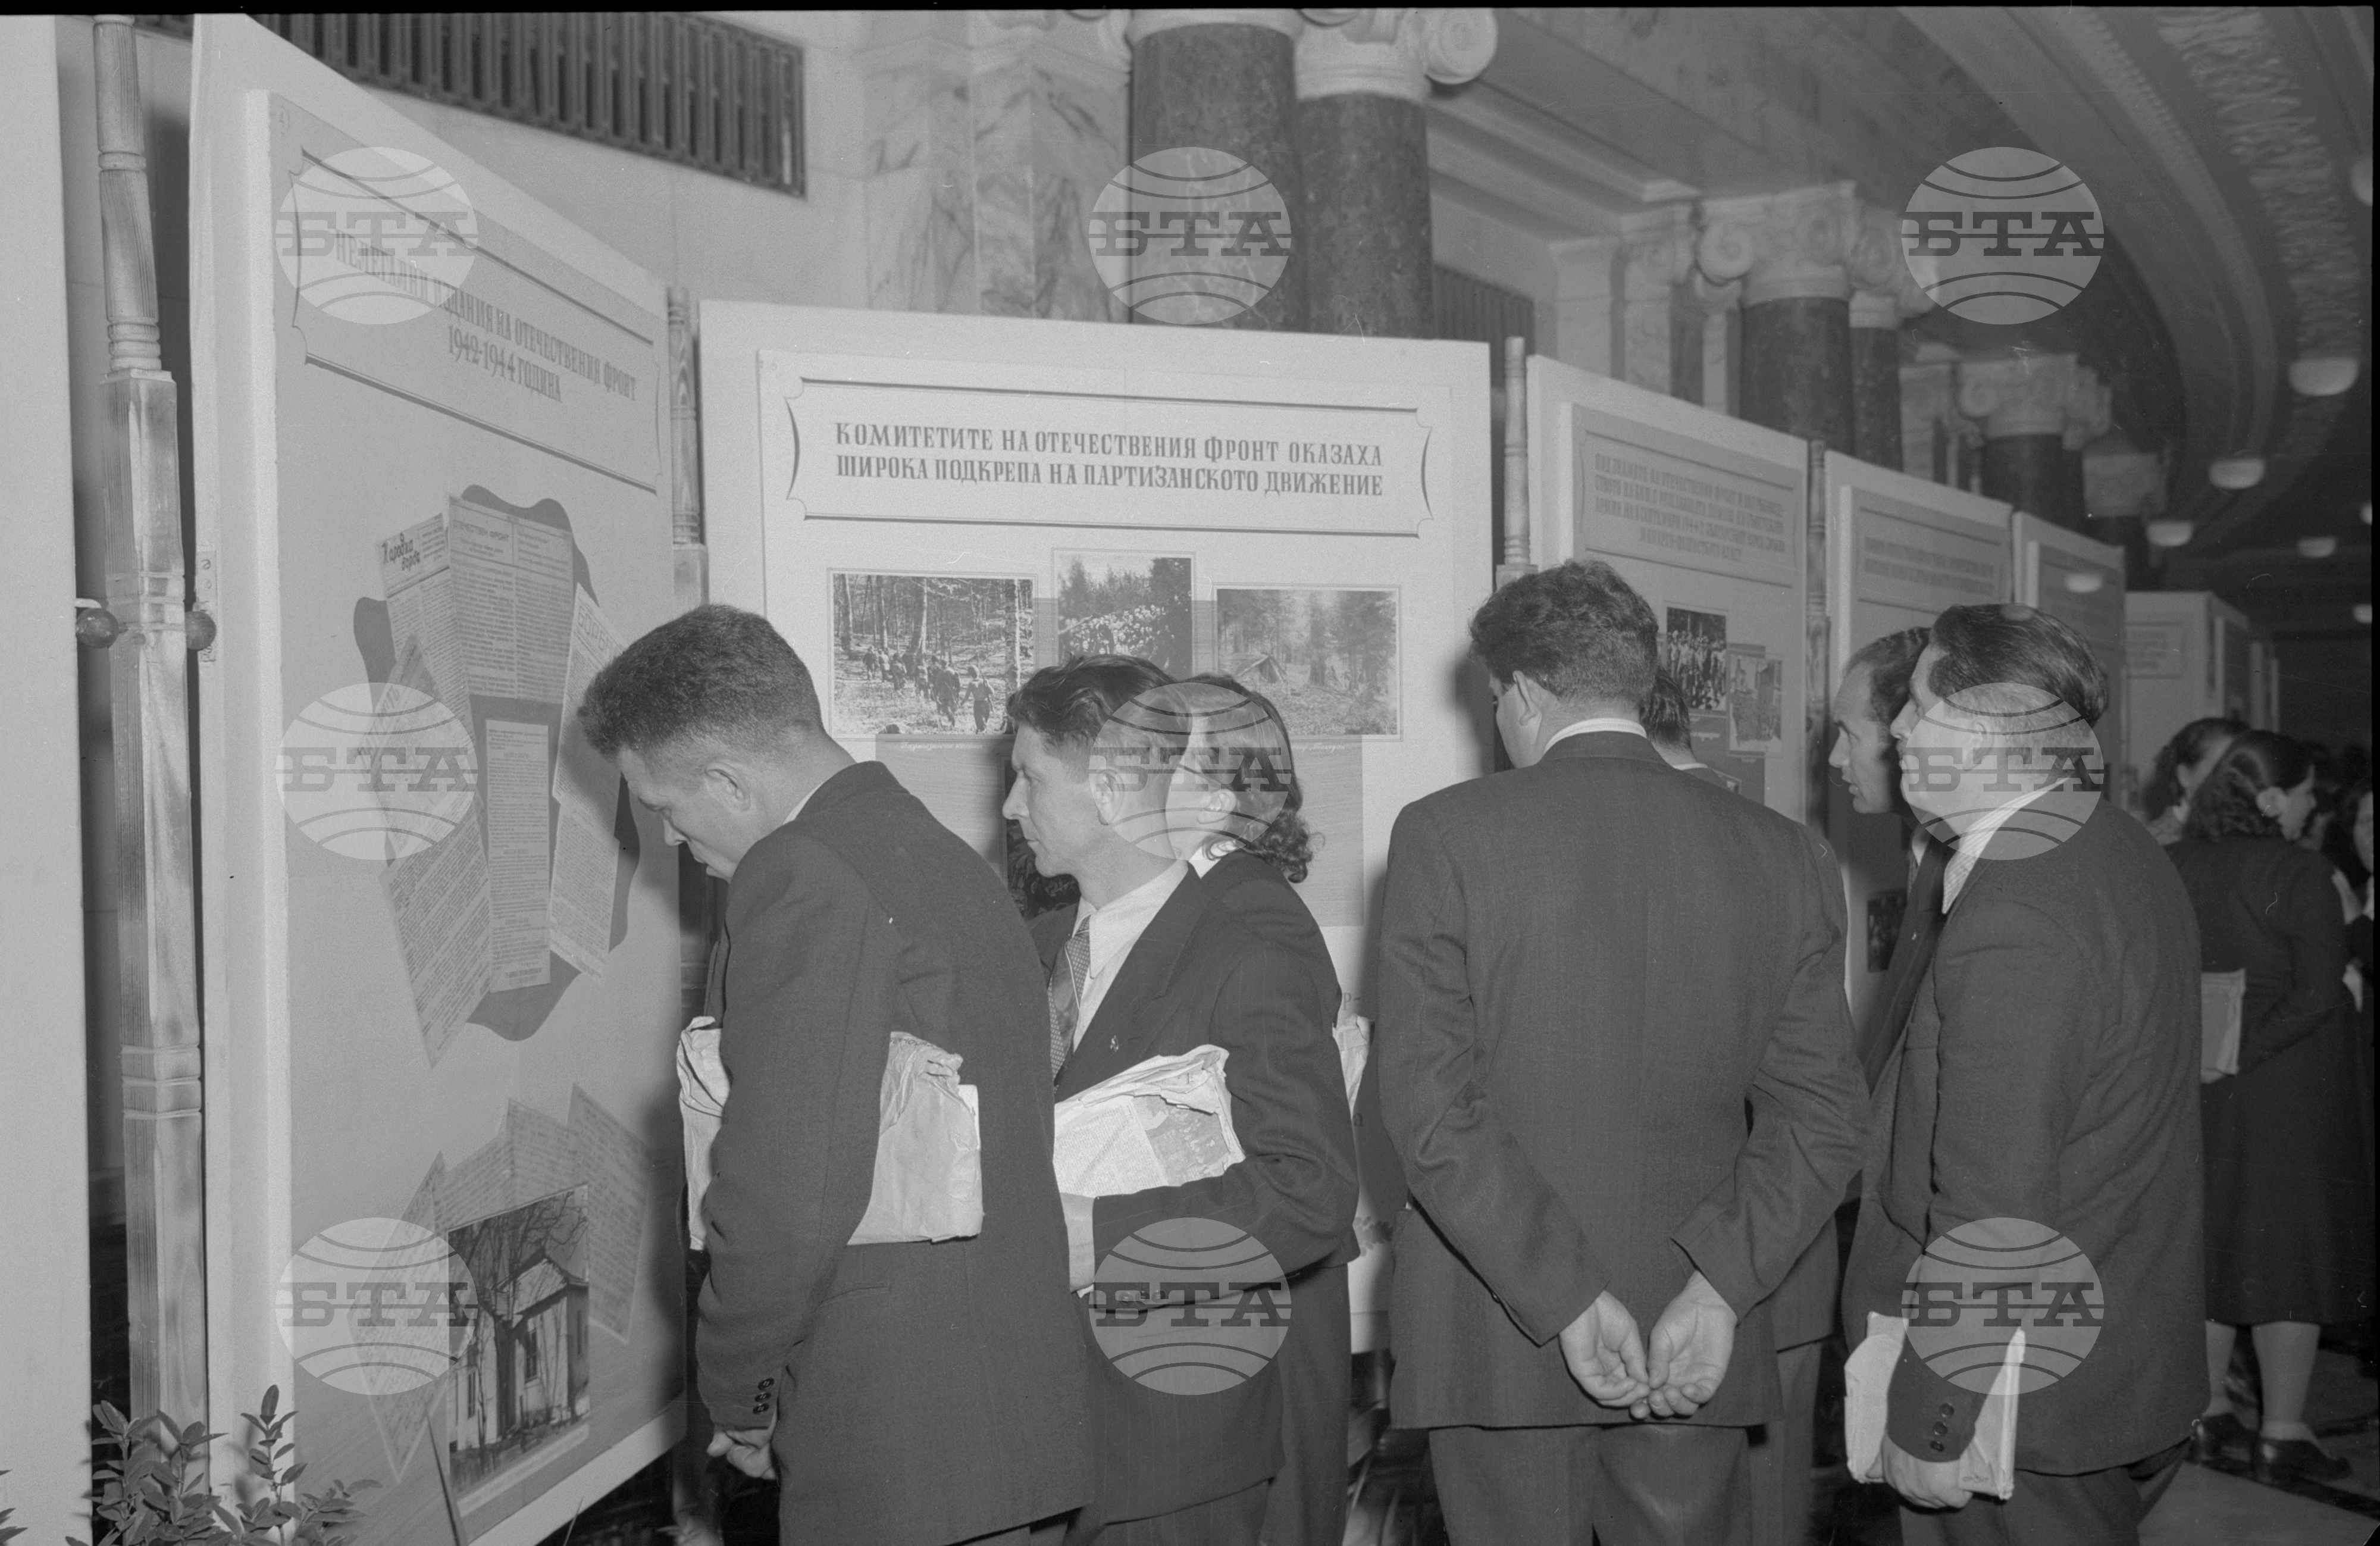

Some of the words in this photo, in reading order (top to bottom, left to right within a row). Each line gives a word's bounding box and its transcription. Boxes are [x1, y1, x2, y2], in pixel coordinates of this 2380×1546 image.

[448, 324, 515, 383] 1942-1944
[518, 356, 562, 403] ГОДИНА
[497, 308, 512, 341] НА
[515, 317, 600, 385] ОТЕЧЕСТВЕНИЯ
[603, 361, 635, 401] ФРОНТ
[835, 422, 993, 450] КОМИТЕТИТЕ
[1001, 429, 1029, 452] НА
[1034, 431, 1196, 458] ОТЕЧЕСТВЕНИЯ
[1204, 436, 1279, 463] ФРОНТ
[1288, 442, 1382, 466] ОКАЗАХА
[835, 454, 929, 480] ШИРОКА
[935, 459, 1042, 486] ПОДКРЕПА
[1050, 462, 1078, 485] НА
[1083, 464, 1258, 492] ПАРТИЗАНСКОТО
[1264, 471, 1383, 497] ДВИЖЕНИЕ
